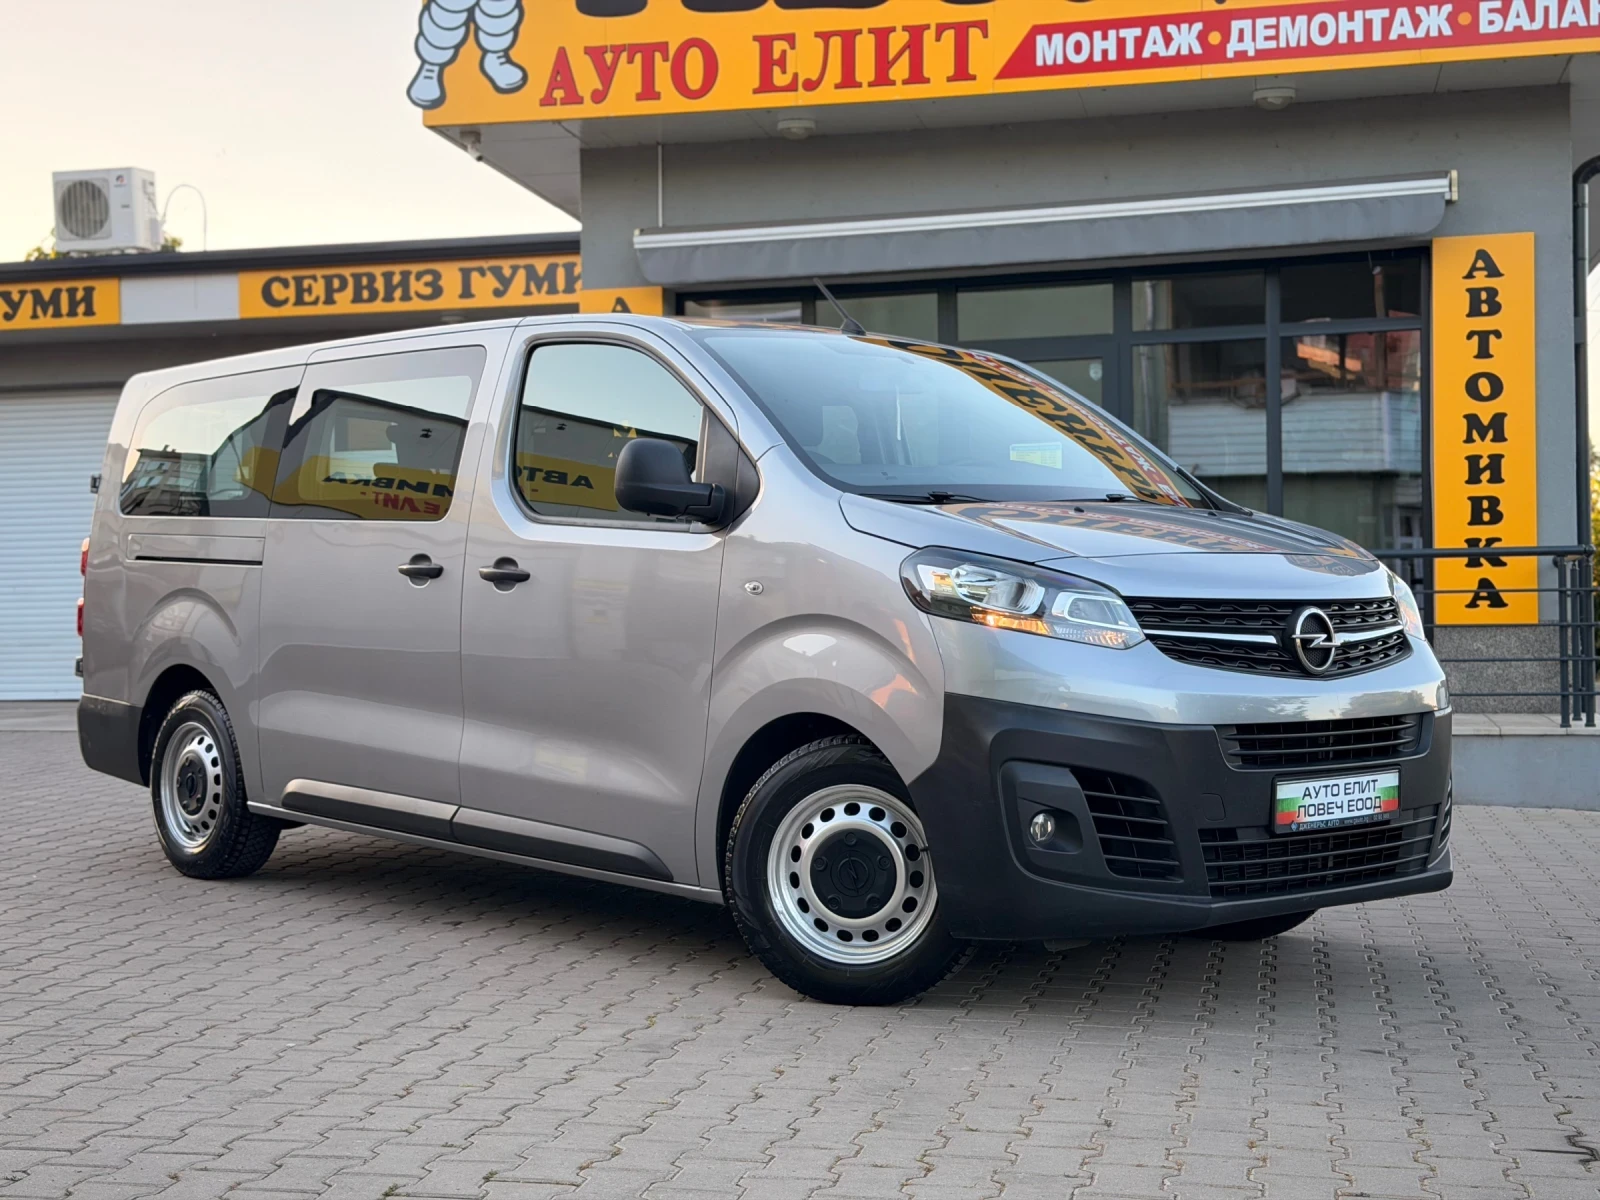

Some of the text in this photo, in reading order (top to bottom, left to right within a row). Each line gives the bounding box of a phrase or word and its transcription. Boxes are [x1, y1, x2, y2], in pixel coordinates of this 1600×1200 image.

[1035, 22, 1203, 66] МОНТАЖ
[1227, 4, 1453, 58] ДЕМОНТАЖ
[539, 19, 989, 107] АУТО ЕЛИТ
[261, 266, 444, 307] СЕРВИЗ
[1461, 248, 1508, 609] АВТОМИВКА
[1296, 796, 1382, 819] ЛОВЕЧ ЕООД
[1301, 779, 1379, 801] АУТО ЕЛИТ
